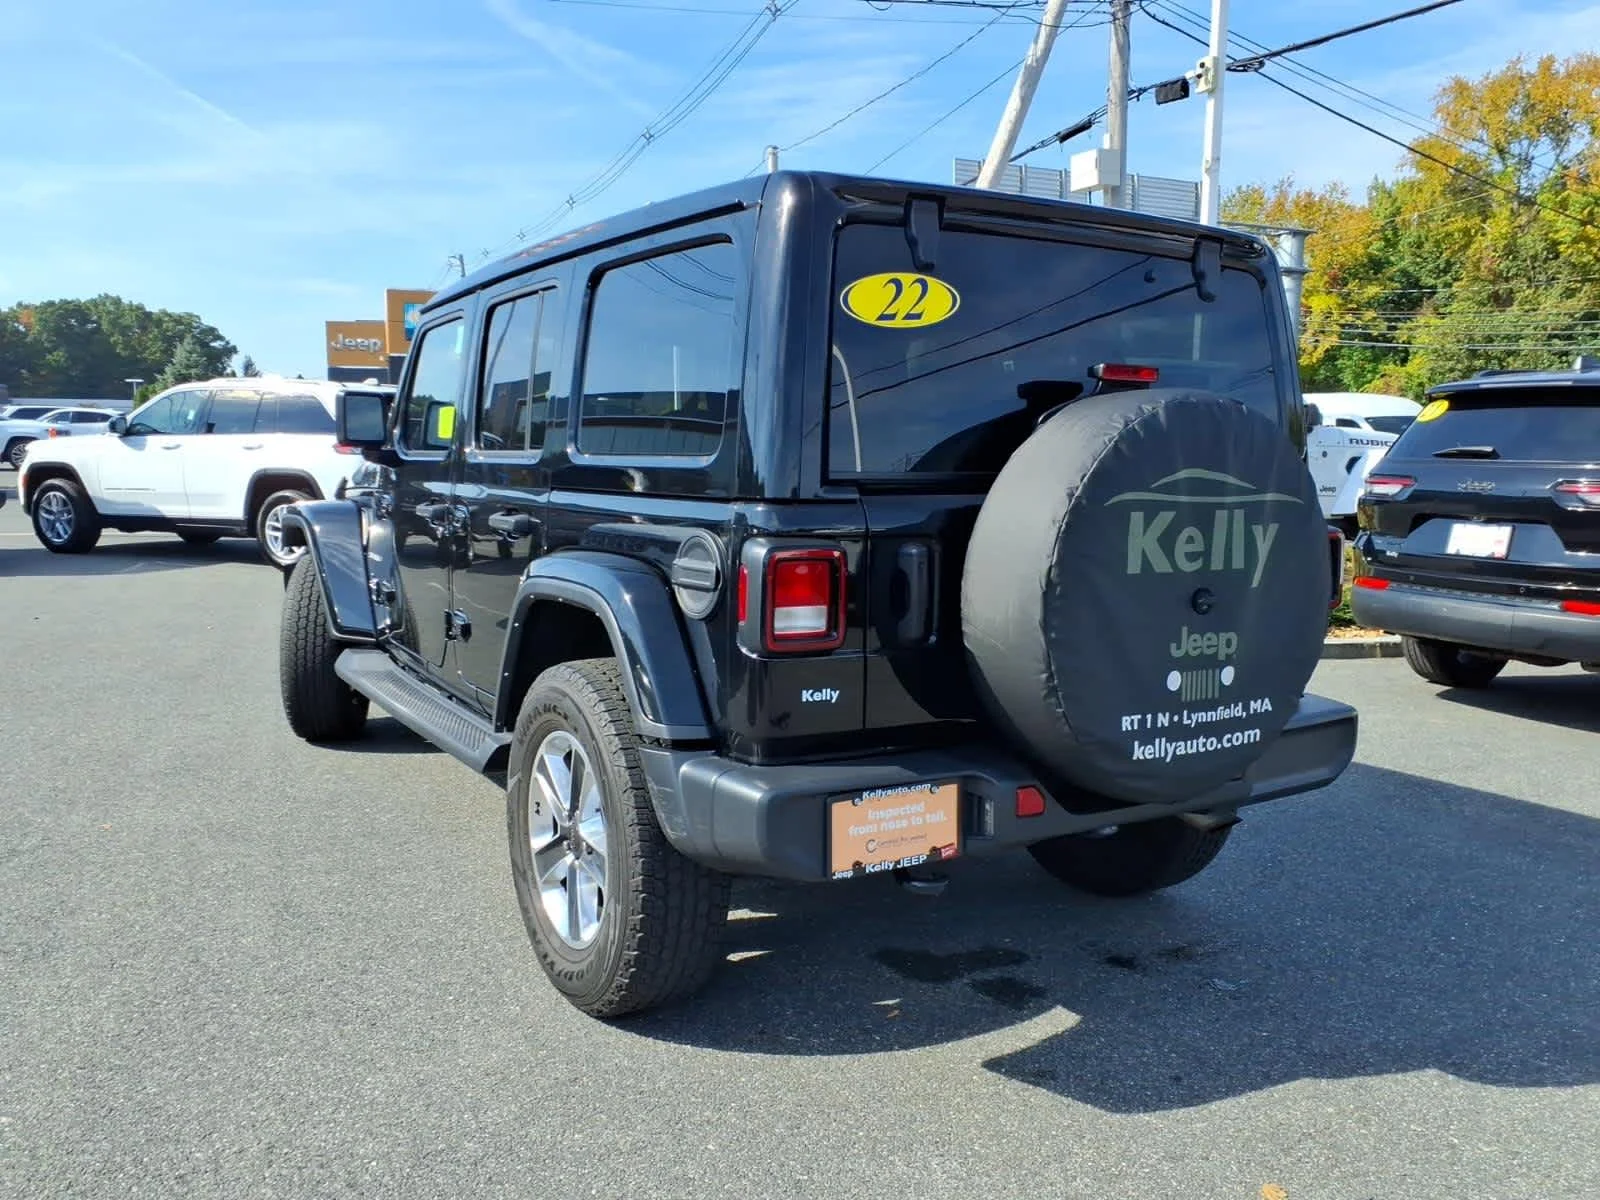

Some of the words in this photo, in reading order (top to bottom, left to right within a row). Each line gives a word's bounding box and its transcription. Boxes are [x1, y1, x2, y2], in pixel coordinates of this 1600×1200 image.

[875, 278, 928, 321] 22
[331, 333, 382, 352] Jeep
[1127, 509, 1280, 588] Kelly
[1170, 626, 1238, 660] Jeep
[802, 688, 840, 703] Kelly
[1121, 715, 1141, 731] RT
[1146, 714, 1152, 729] 1
[1157, 712, 1170, 728] N
[1182, 702, 1246, 728] Lynnfield,
[1250, 698, 1272, 714] MA
[1132, 728, 1261, 762] kellyauto.com
[862, 783, 931, 799] Kellyauto.com
[868, 801, 926, 820] Inspected
[848, 823, 878, 837] from
[880, 818, 908, 832] nose
[911, 814, 922, 825] to
[865, 860, 895, 873] Kelly
[897, 855, 927, 868] JEEP
[832, 870, 854, 880] Jeep
